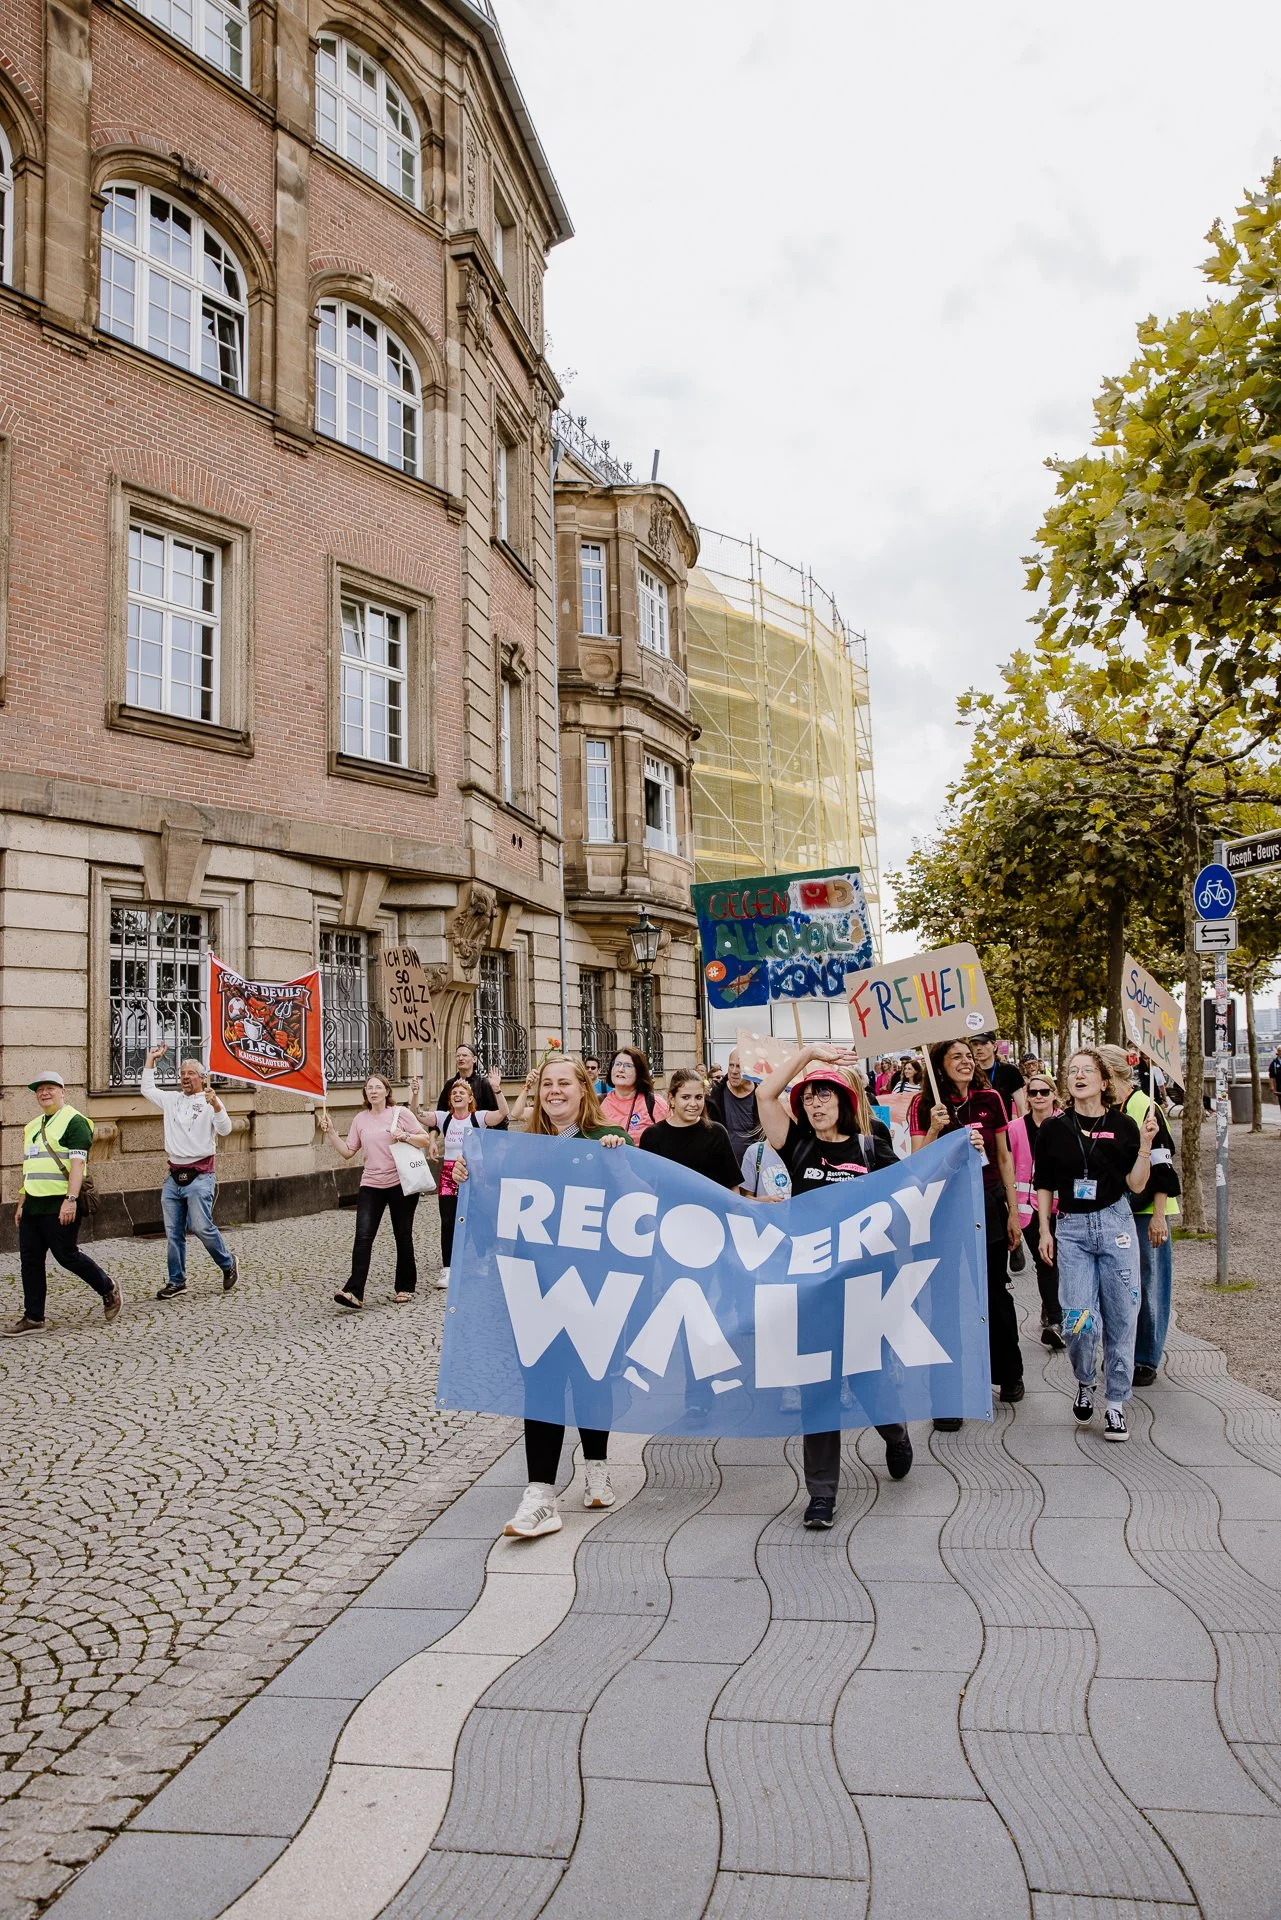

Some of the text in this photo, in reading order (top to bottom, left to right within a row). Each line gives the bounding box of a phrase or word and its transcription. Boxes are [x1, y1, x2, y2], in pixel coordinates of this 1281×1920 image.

[709, 889, 790, 920] GEGEN
[715, 921, 854, 961] ALKOHOL
[384, 949, 421, 969] ICH BIN
[260, 986, 302, 998] DEVILS
[395, 969, 410, 984] SO
[1126, 969, 1160, 1015] Sober
[389, 984, 430, 1005] STOLZ
[849, 963, 980, 1038] FREIHEIT
[395, 1012, 437, 1043] UNS!
[1142, 1017, 1171, 1066] Fuck
[238, 1049, 290, 1068] KAISERSLAUTERN
[247, 1039, 277, 1057] 1.FC
[496, 1177, 946, 1276] RECOVERY
[495, 1254, 954, 1395] WALK
